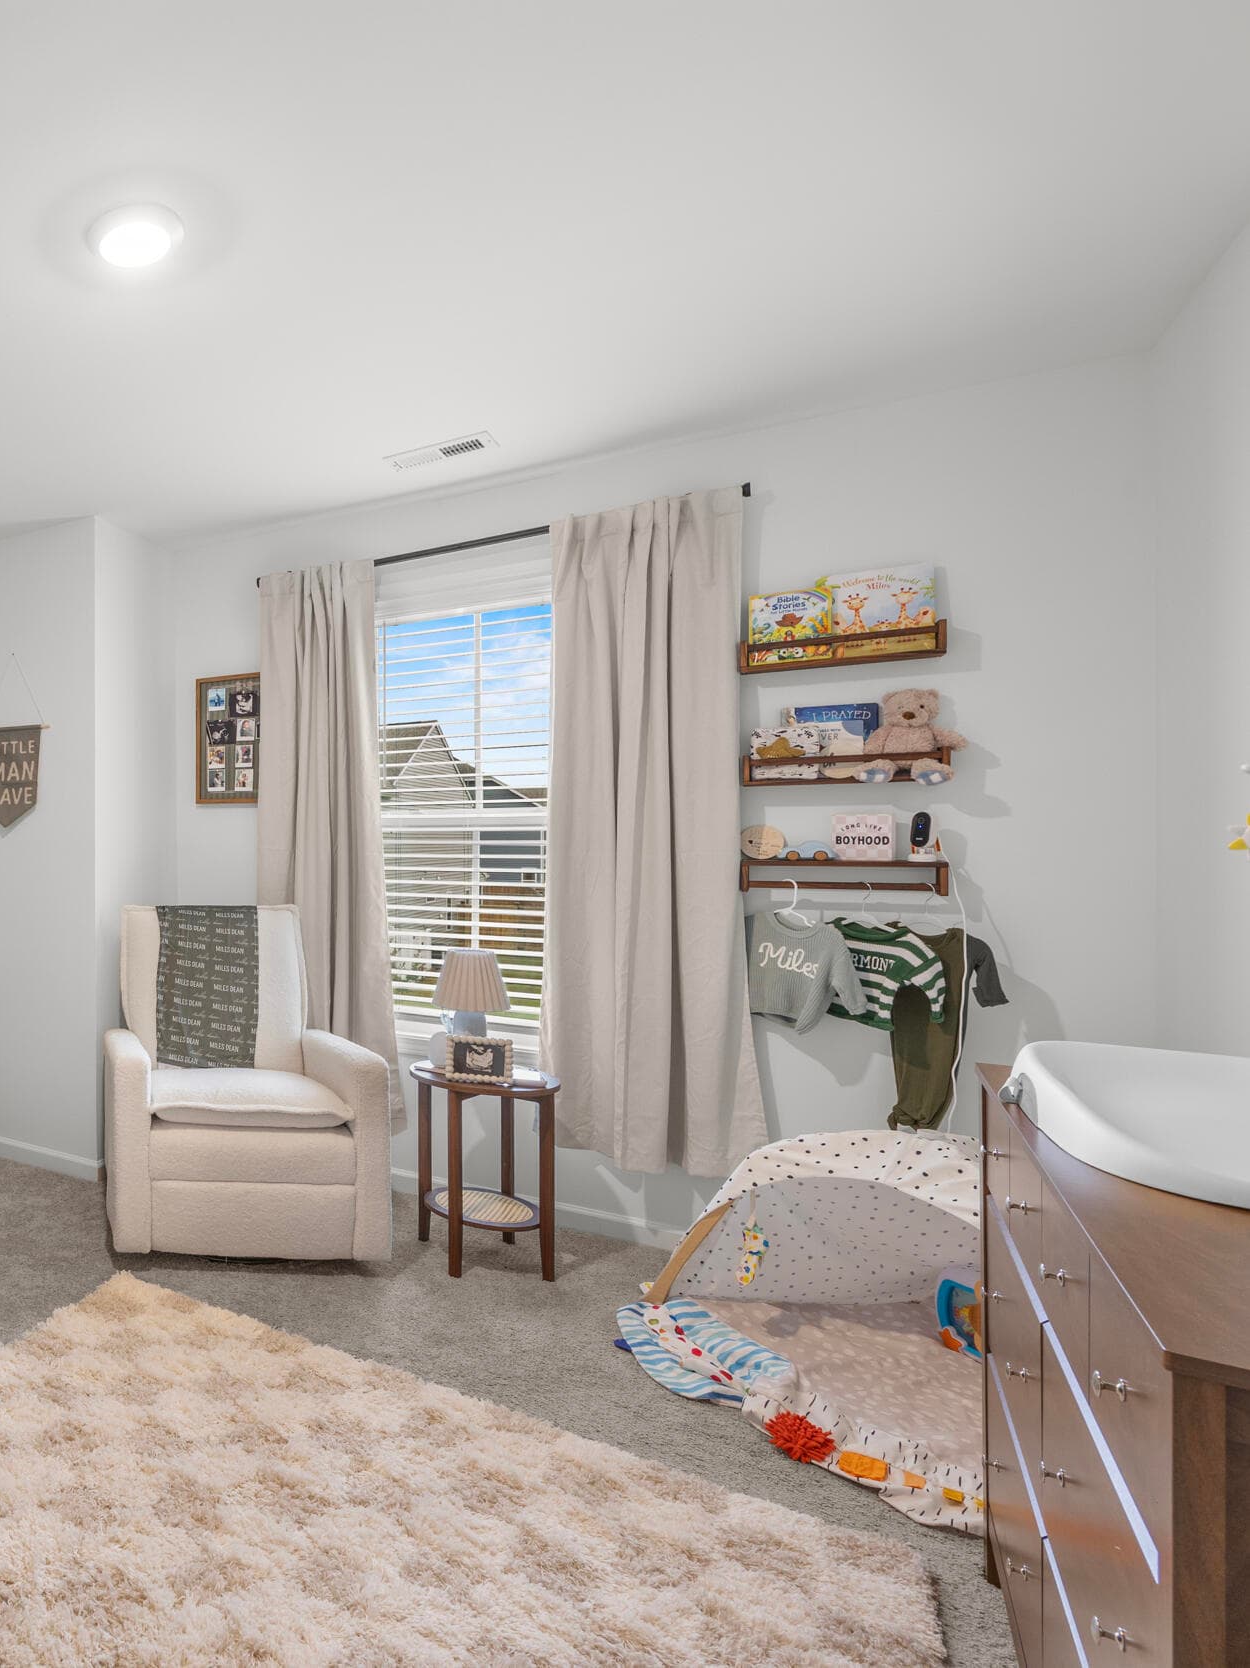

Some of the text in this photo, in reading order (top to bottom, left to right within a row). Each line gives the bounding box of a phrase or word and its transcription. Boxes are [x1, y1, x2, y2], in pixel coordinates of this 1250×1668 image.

[866, 582, 891, 590] Miles
[777, 595, 800, 603] Bible
[772, 601, 806, 611] Stories
[812, 710, 872, 722] I PRAYED
[840, 822, 861, 832] LONG
[835, 836, 890, 845] BOYHOOD
[178, 940, 206, 950] MILES DEAN
[215, 945, 230, 953] MILES
[177, 959, 191, 967] MILES
[758, 942, 819, 979] Miles
[851, 952, 895, 972] RMONT
[215, 964, 244, 974] MILES DEAN
[175, 977, 203, 988] MILES DEAN
[213, 983, 244, 993] MILES DEAN
[174, 996, 188, 1005] MILES
[212, 1002, 228, 1011] MILES
[229, 1005, 243, 1013] DEAN
[172, 1015, 187, 1024] MILES
[187, 1018, 201, 1026] DEAN
[211, 1021, 226, 1031] MILES
[227, 1024, 240, 1033] DEAN
[171, 1034, 185, 1043] MILES
[186, 1037, 199, 1046] DEAN
[210, 1041, 239, 1053] MILES DEAN
[169, 1054, 198, 1064] MILES DEAN
